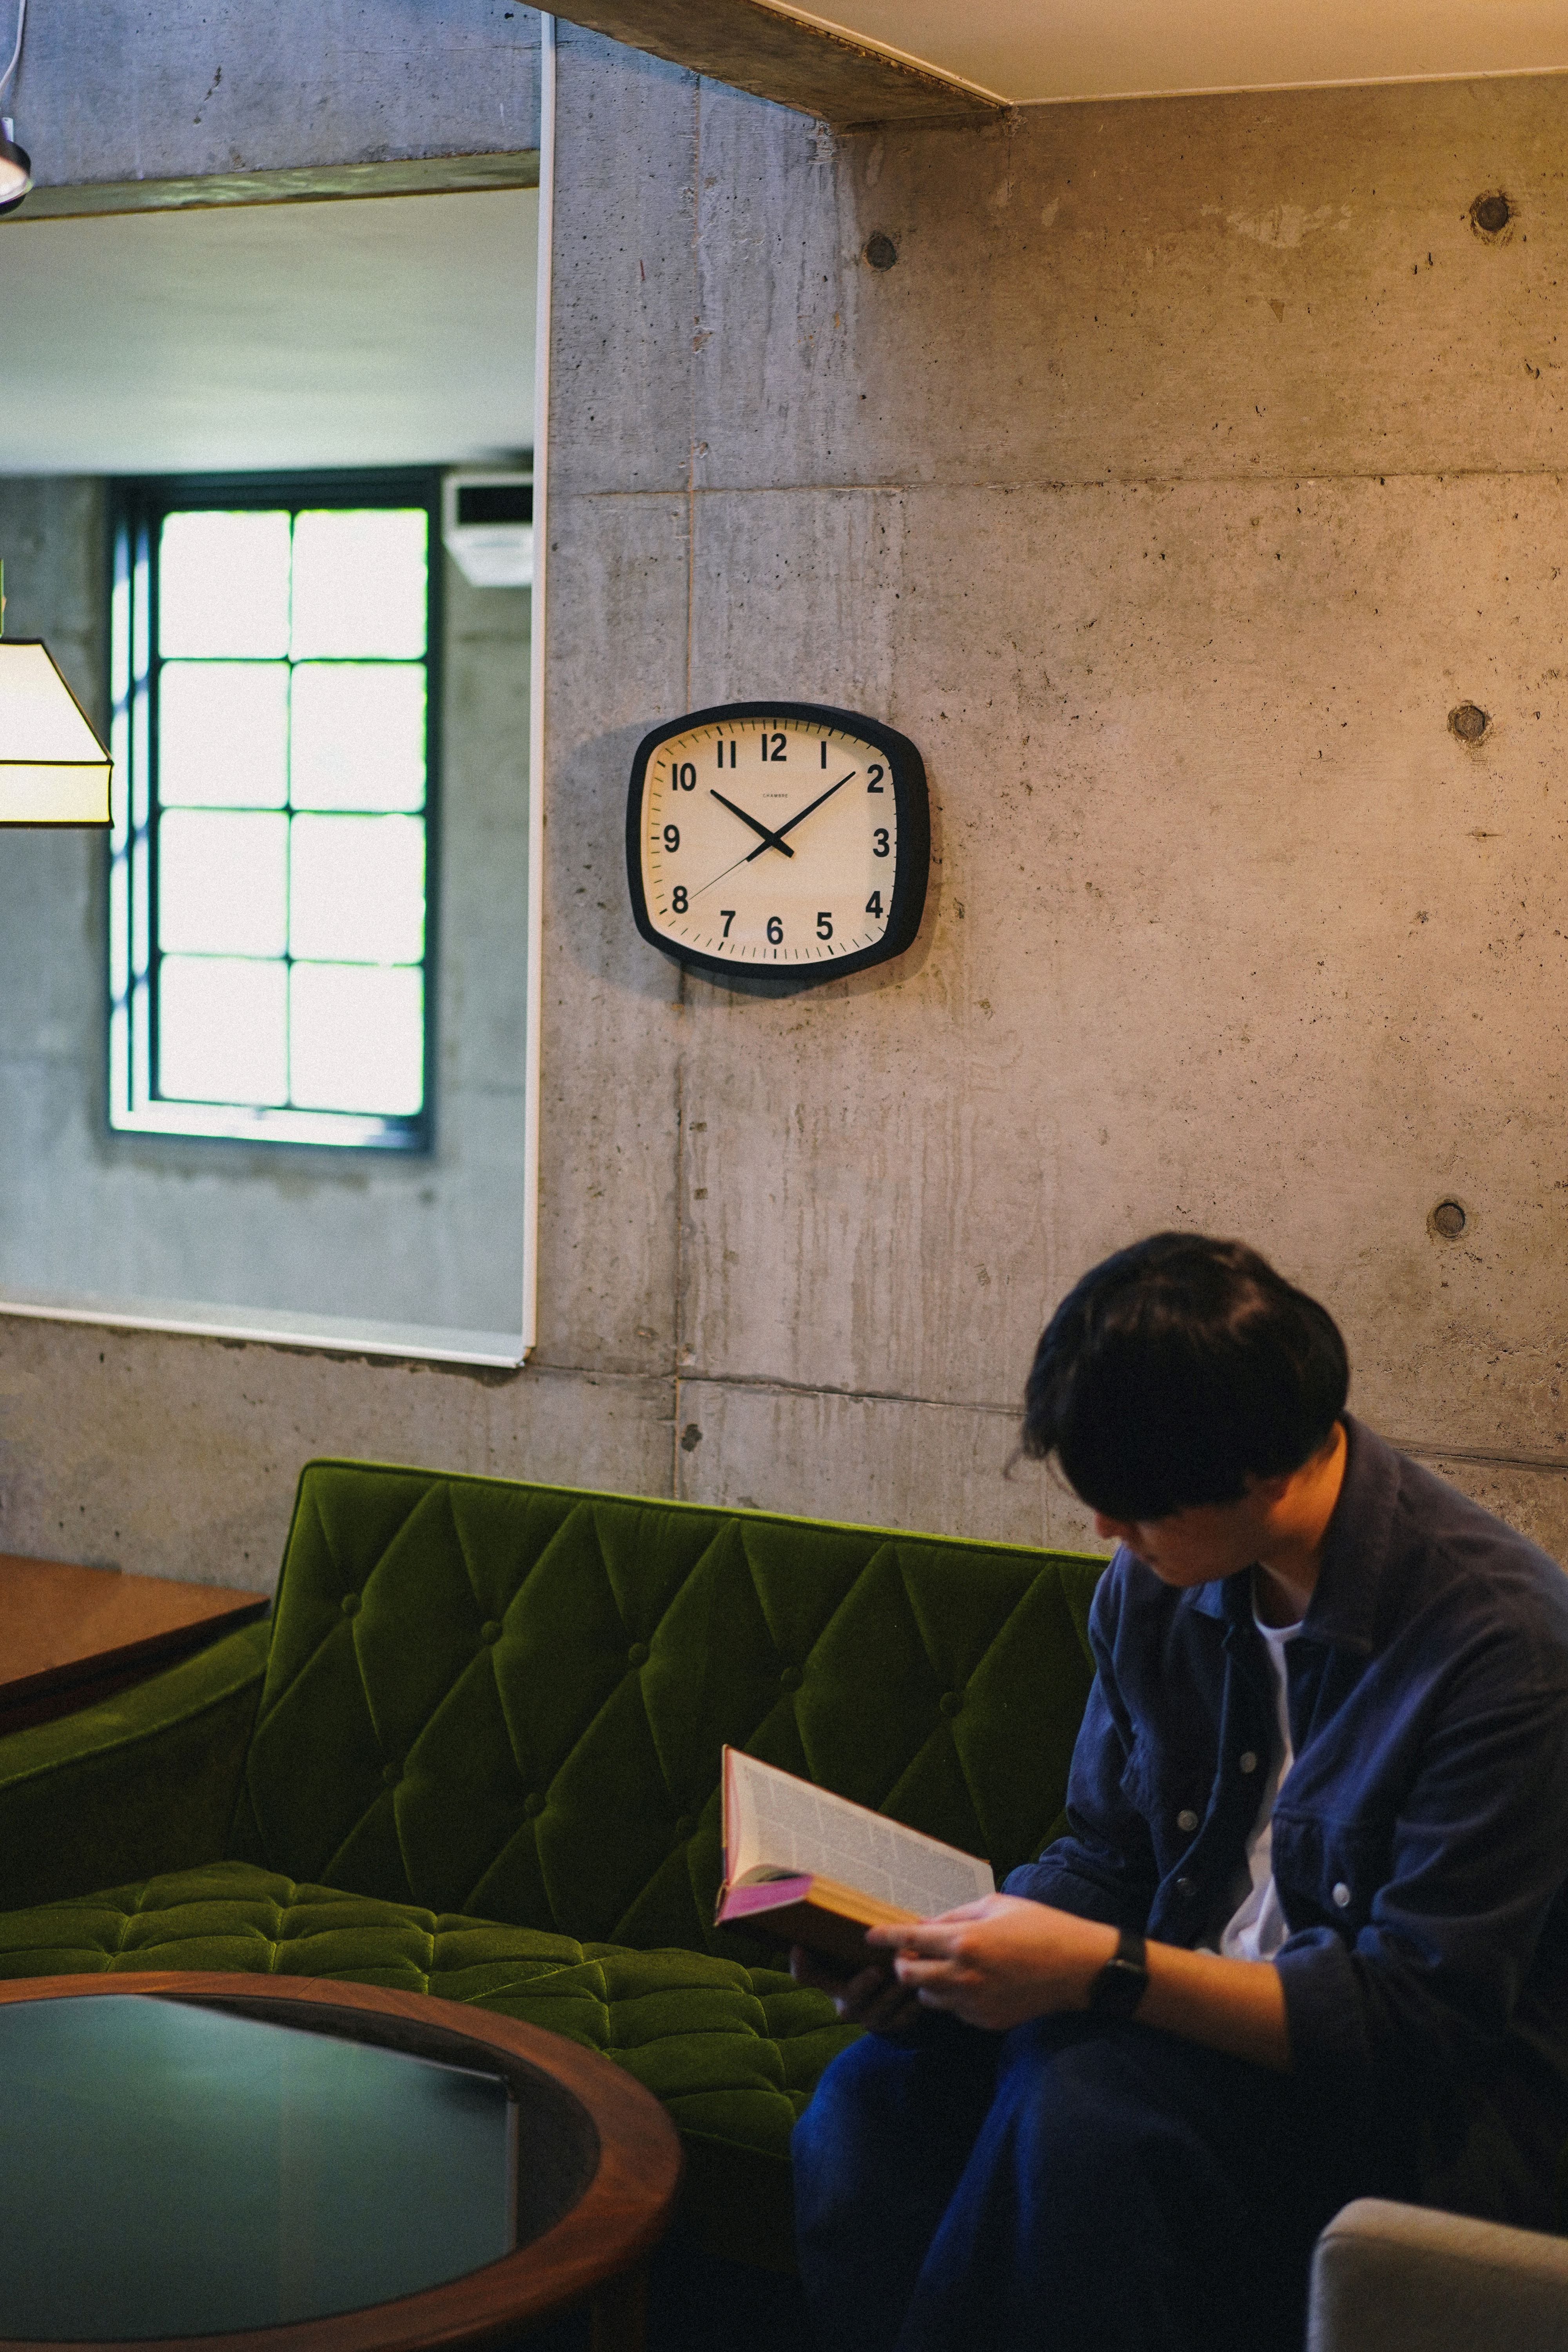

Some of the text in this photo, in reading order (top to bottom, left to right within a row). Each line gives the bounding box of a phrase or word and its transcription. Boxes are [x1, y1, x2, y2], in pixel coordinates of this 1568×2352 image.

[717, 740, 736, 768] 11
[762, 733, 786, 762] 12
[821, 741, 827, 769] 1
[672, 763, 696, 791] 10
[867, 764, 884, 793] 2
[663, 824, 680, 853] 9
[873, 828, 890, 857] 3
[672, 886, 688, 914] 8
[866, 891, 883, 919] 4
[720, 910, 736, 937] 7
[767, 916, 783, 945] 6
[817, 912, 833, 940] 5
